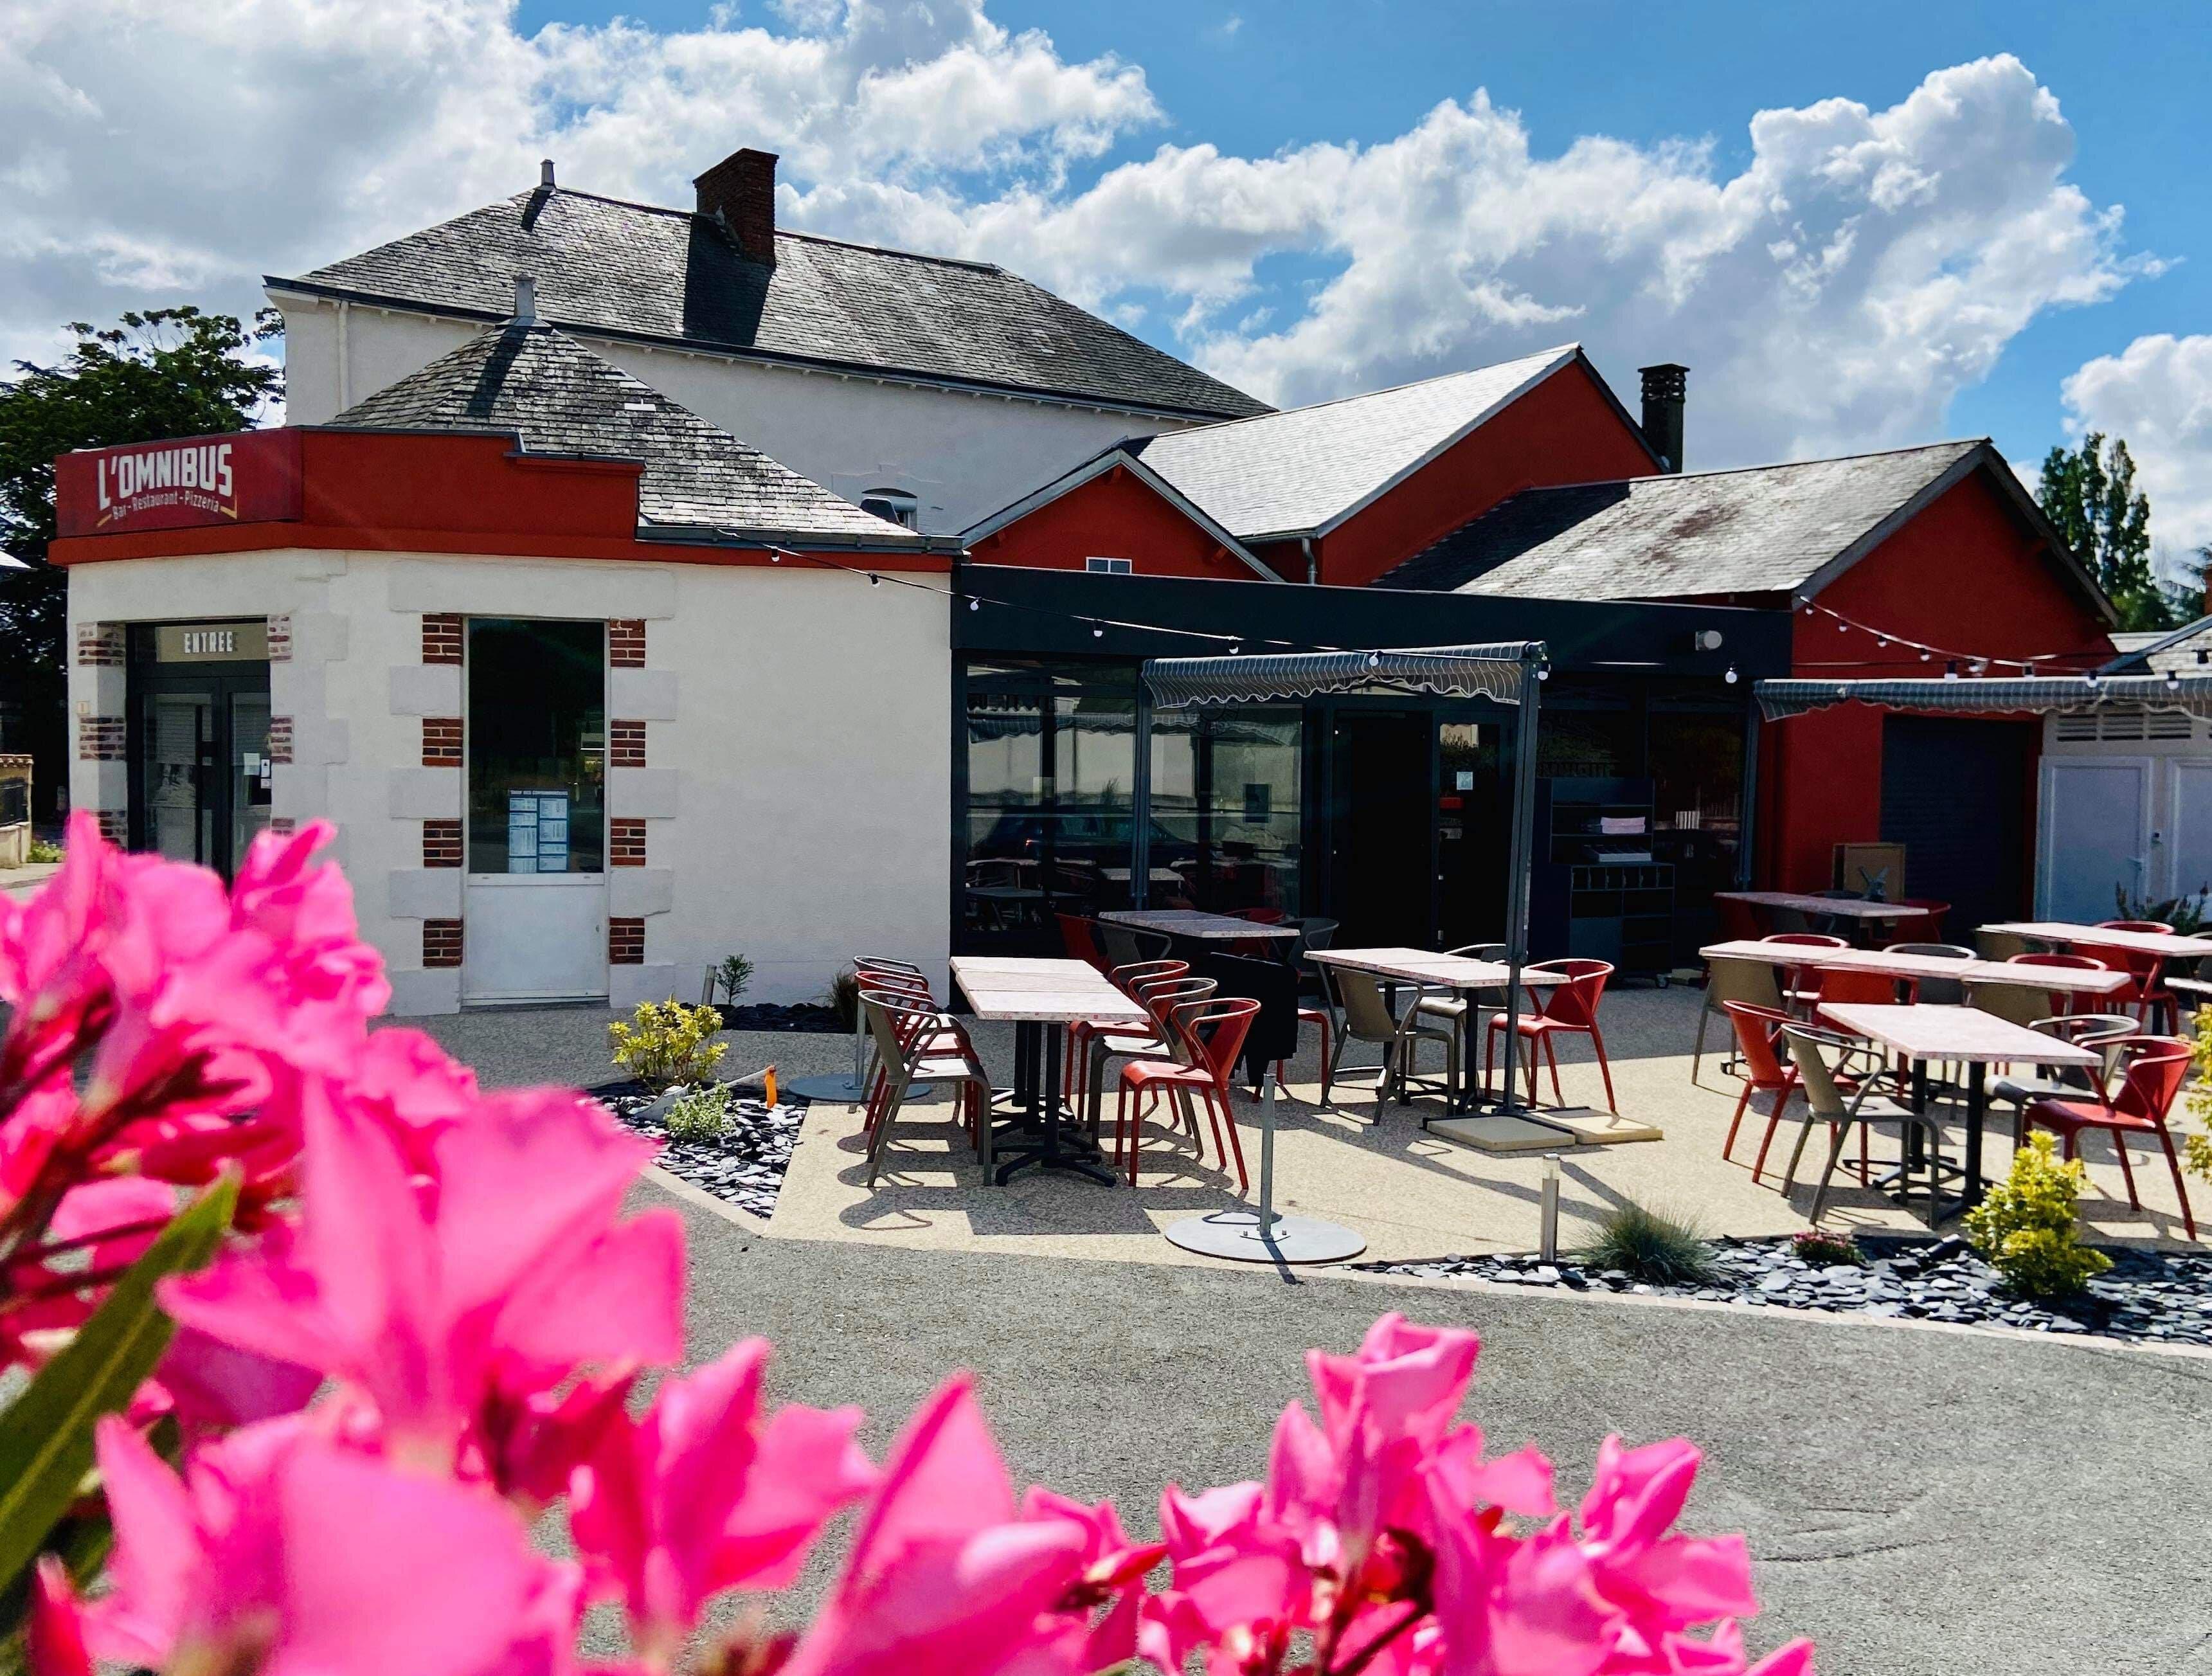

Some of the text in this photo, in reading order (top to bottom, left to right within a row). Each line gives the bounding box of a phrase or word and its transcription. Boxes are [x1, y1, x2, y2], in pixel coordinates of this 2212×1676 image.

[98, 443, 233, 510] L'OMNIBUS
[132, 491, 178, 512] Restaurant
[184, 490, 220, 513] Pizzeria
